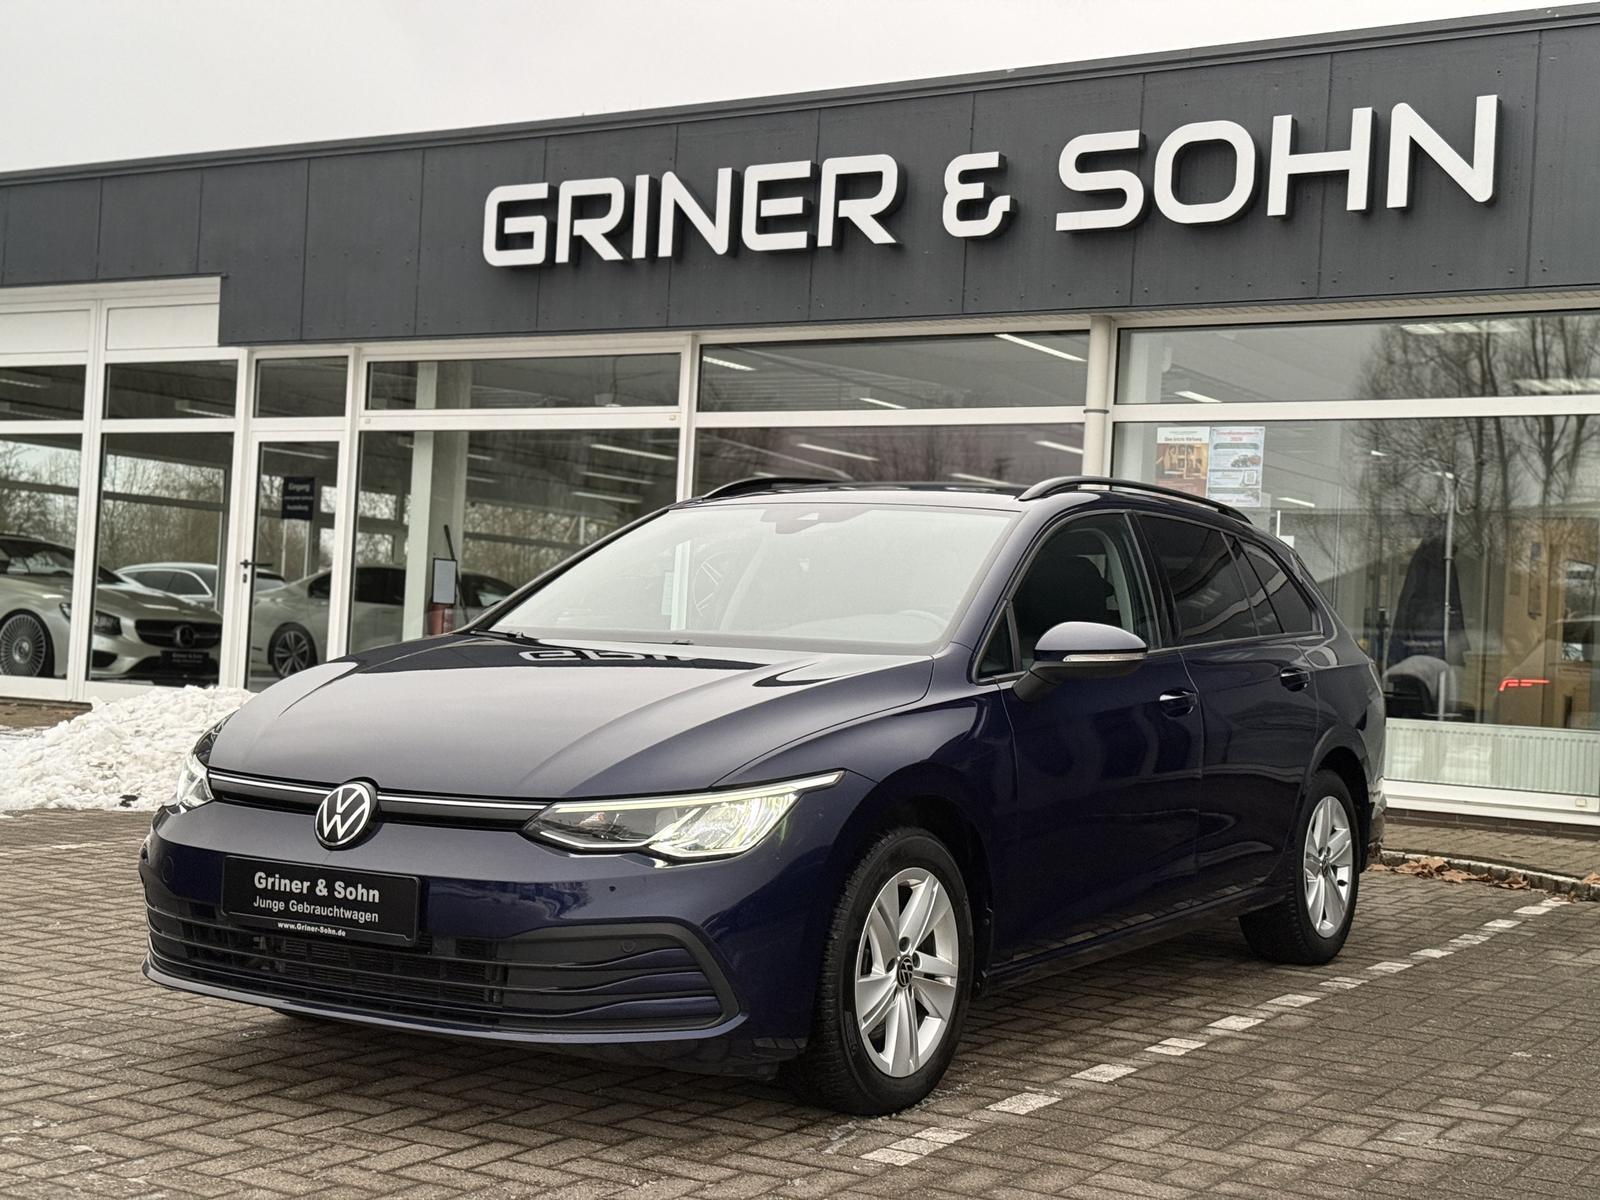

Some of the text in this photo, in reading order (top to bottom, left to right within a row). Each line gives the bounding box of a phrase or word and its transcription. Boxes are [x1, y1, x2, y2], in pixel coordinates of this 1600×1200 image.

[481, 94, 1499, 268] GRINER & SOHN
[254, 871, 380, 903] Griner & Sohn
[253, 895, 379, 924] Junge Gebrauchtwagen
[277, 920, 347, 937] www.Griner-Sohn.de
